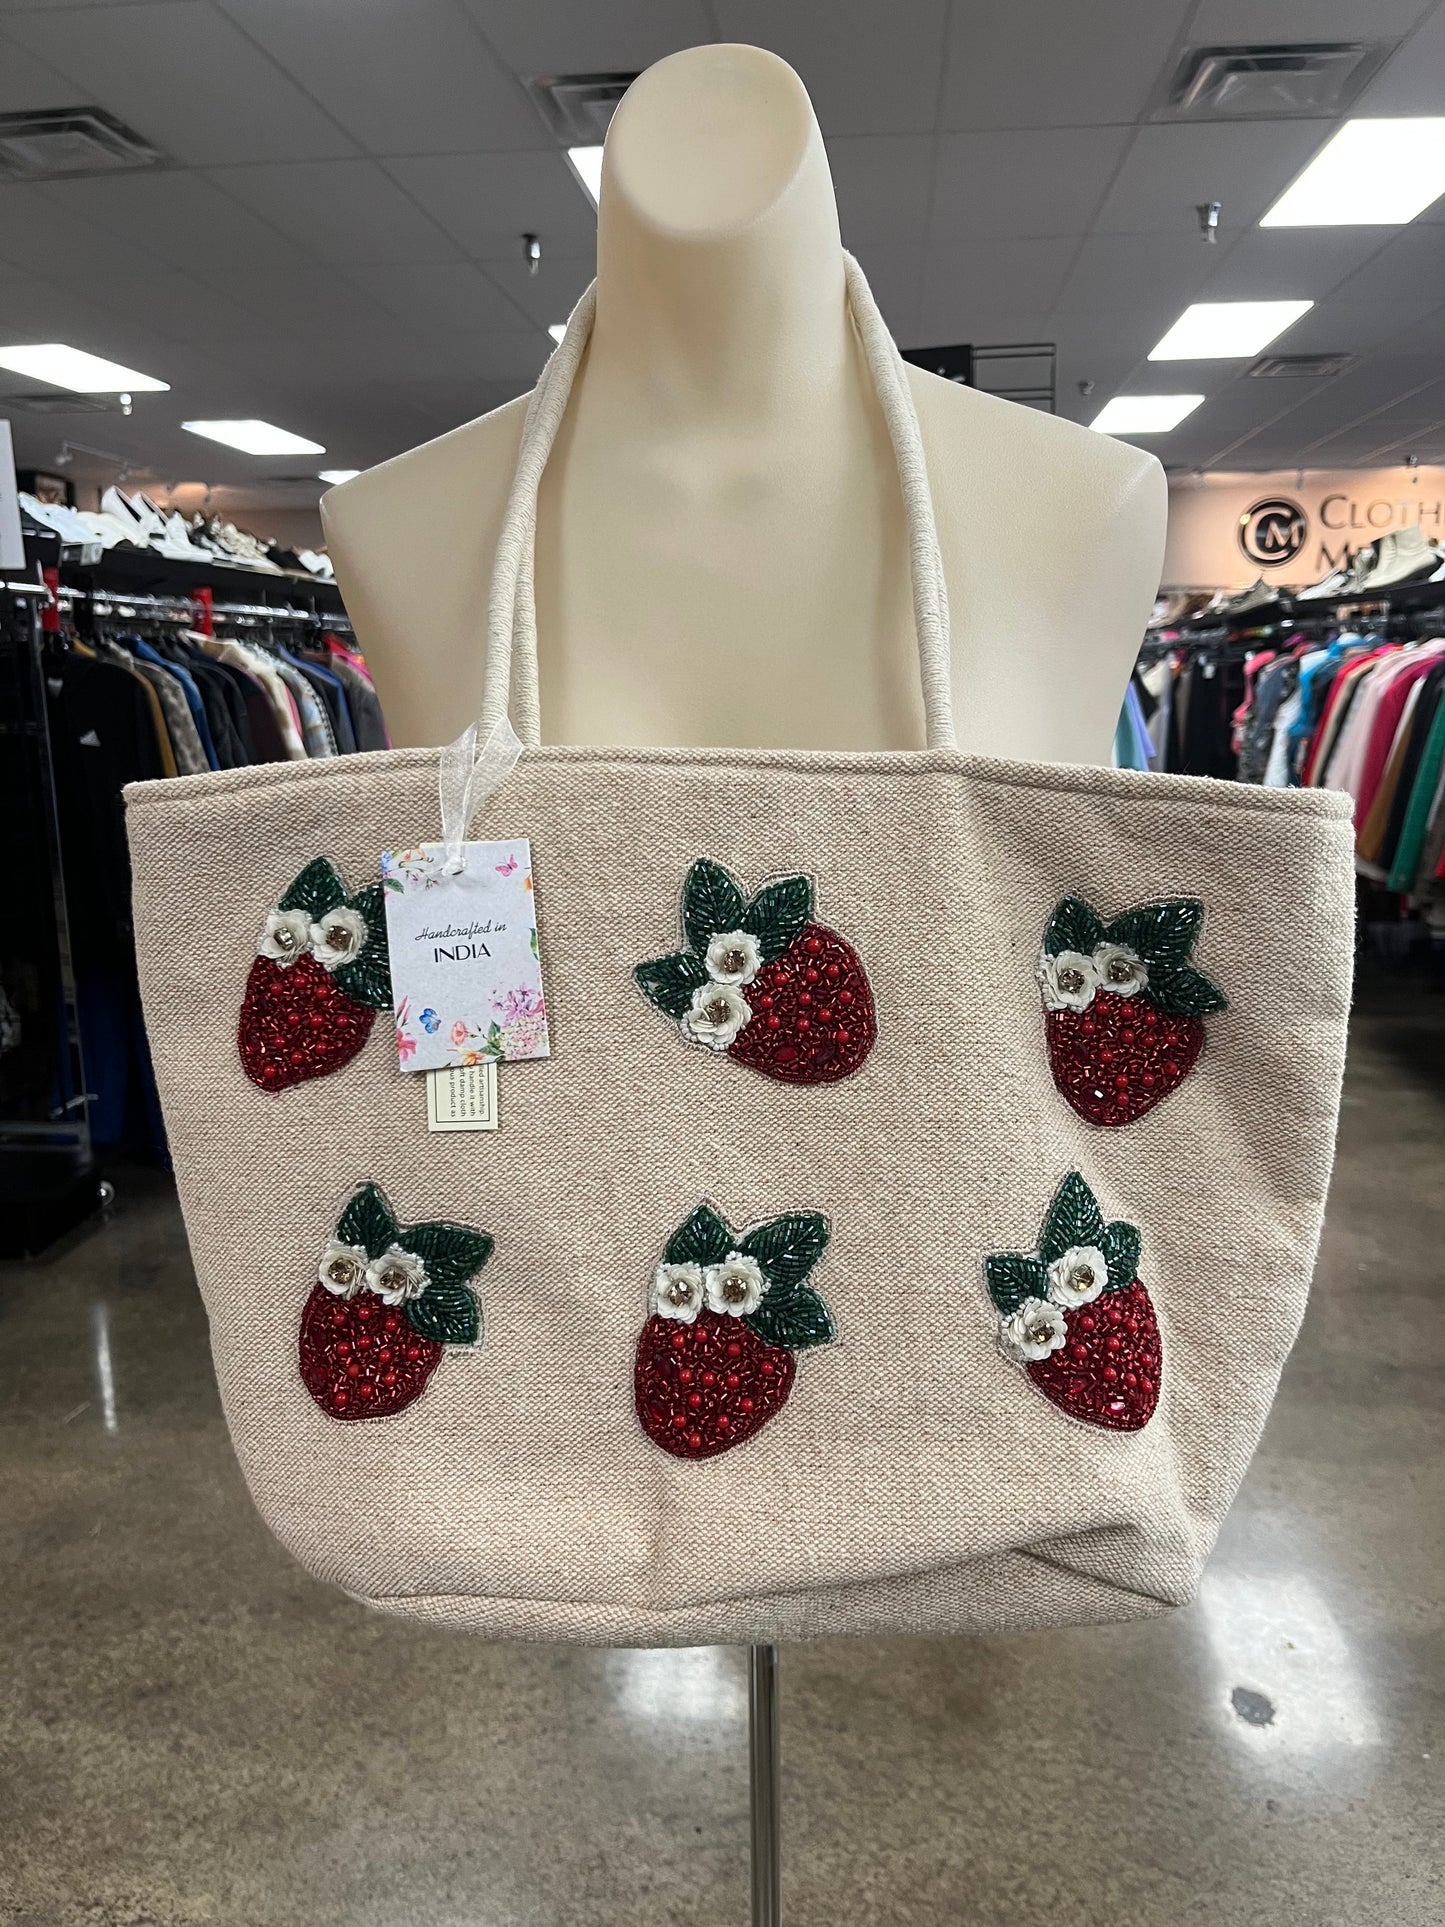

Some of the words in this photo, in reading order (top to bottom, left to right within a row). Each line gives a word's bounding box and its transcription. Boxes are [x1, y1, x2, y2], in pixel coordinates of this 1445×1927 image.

[1319, 493, 1445, 530] CLOTH
[414, 919, 492, 941] Handcrafted
[494, 922, 507, 932] in
[433, 942, 492, 963] INDIA
[450, 1109, 456, 1118] as
